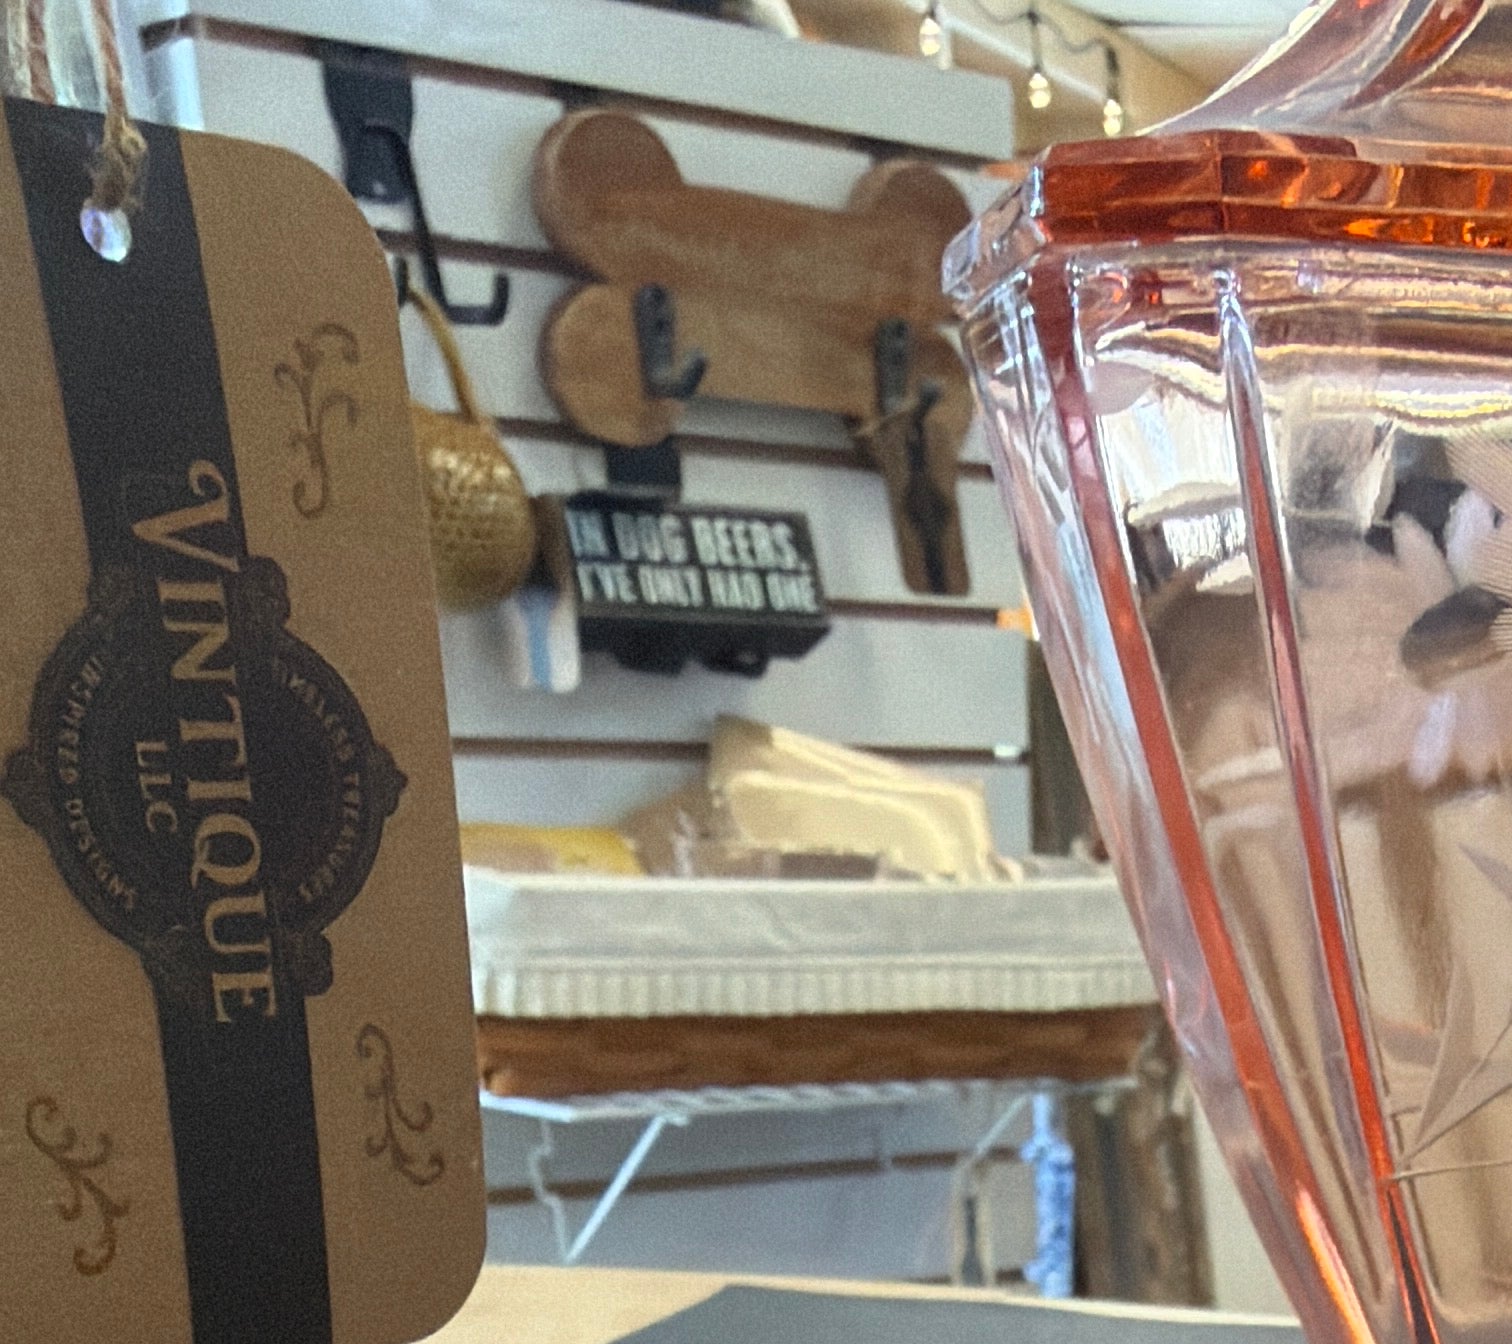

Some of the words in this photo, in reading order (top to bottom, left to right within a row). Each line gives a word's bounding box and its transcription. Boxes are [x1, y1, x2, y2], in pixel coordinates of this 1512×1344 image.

[612, 511, 688, 563] DOG
[638, 564, 703, 607] ONLY
[131, 459, 277, 1023] VINTIQUE
[135, 739, 178, 834] LLC
